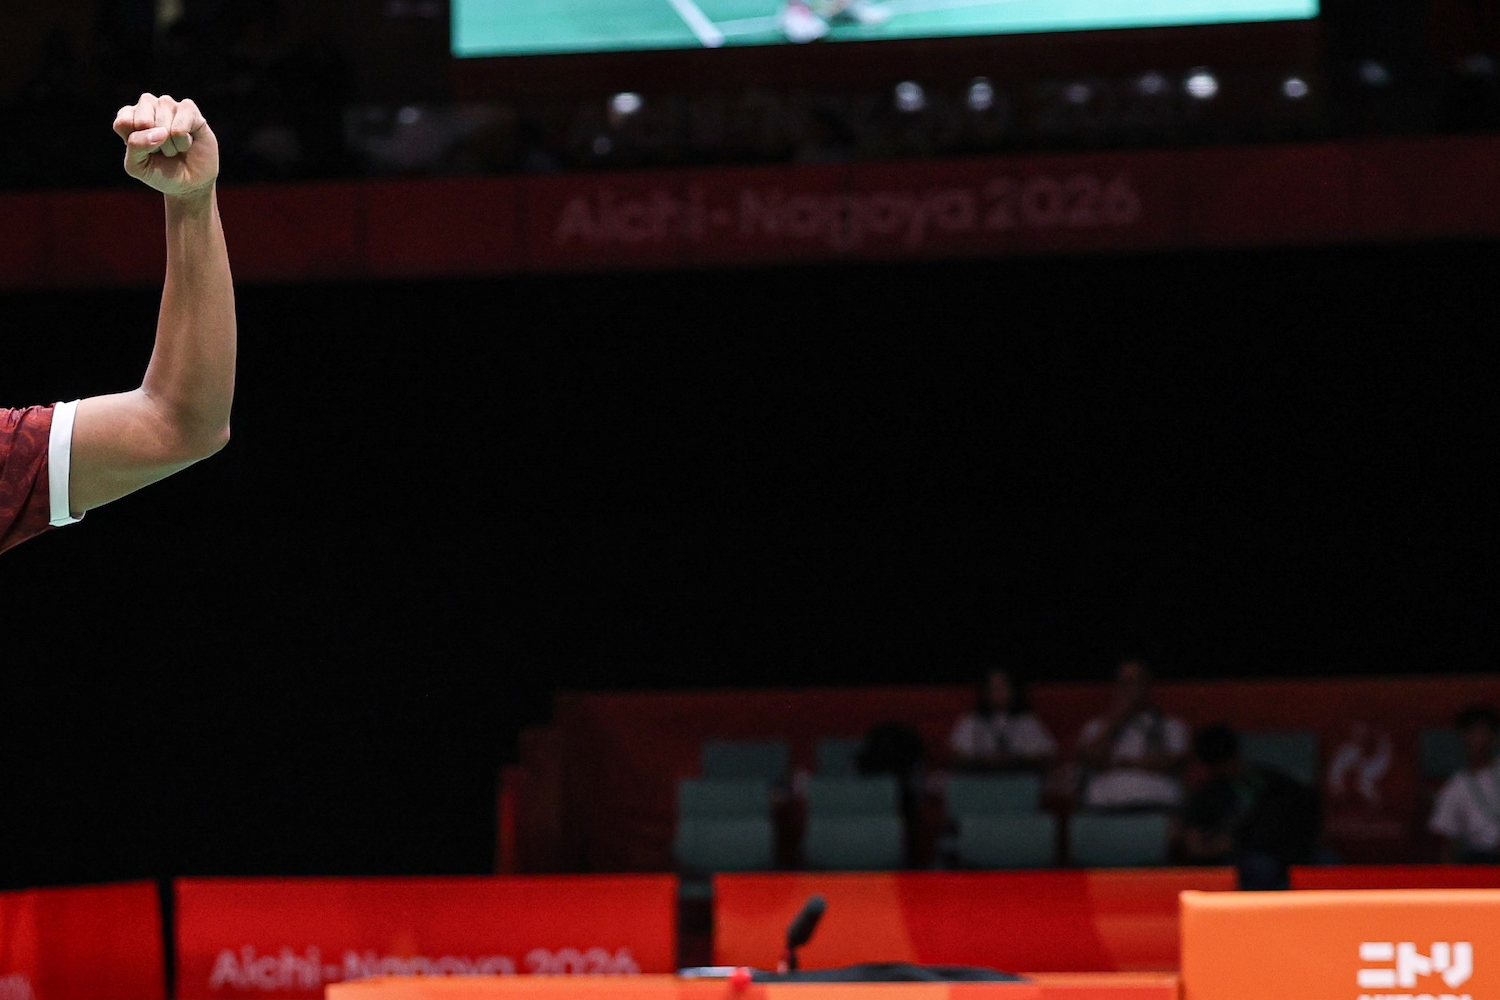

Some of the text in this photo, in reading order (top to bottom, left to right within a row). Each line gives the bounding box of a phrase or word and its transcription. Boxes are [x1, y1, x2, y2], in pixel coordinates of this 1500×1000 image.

[552, 172, 1143, 250] Aichi-Nagoya 2026
[1357, 941, 1474, 989] ニトリ
